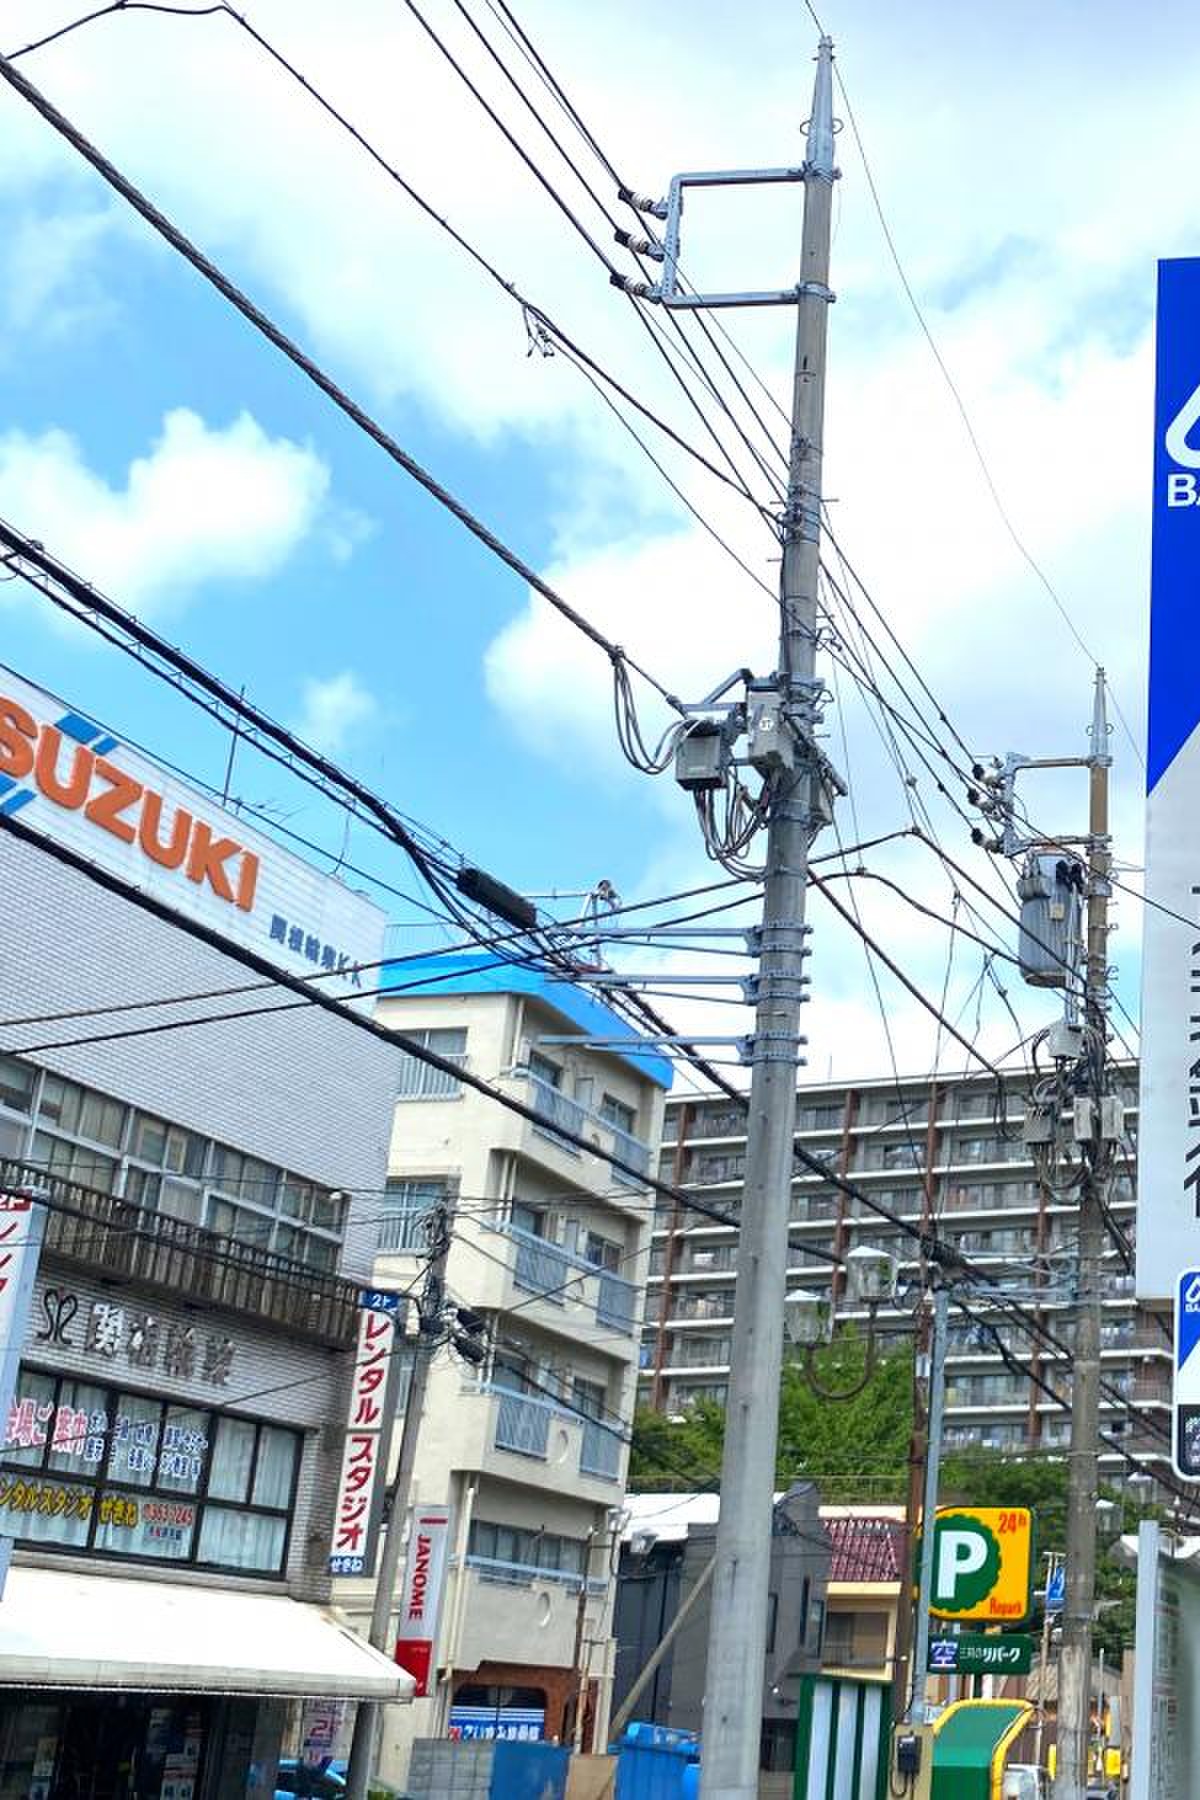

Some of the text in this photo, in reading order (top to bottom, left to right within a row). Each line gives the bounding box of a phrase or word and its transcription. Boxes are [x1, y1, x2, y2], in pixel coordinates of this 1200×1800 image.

[0, 696, 261, 913] SUZUKI
[336, 1313, 391, 1550] レンタル スタジオ
[408, 1533, 432, 1621] JANOME
[937, 1530, 989, 1599] P
[929, 1640, 958, 1669] 空
